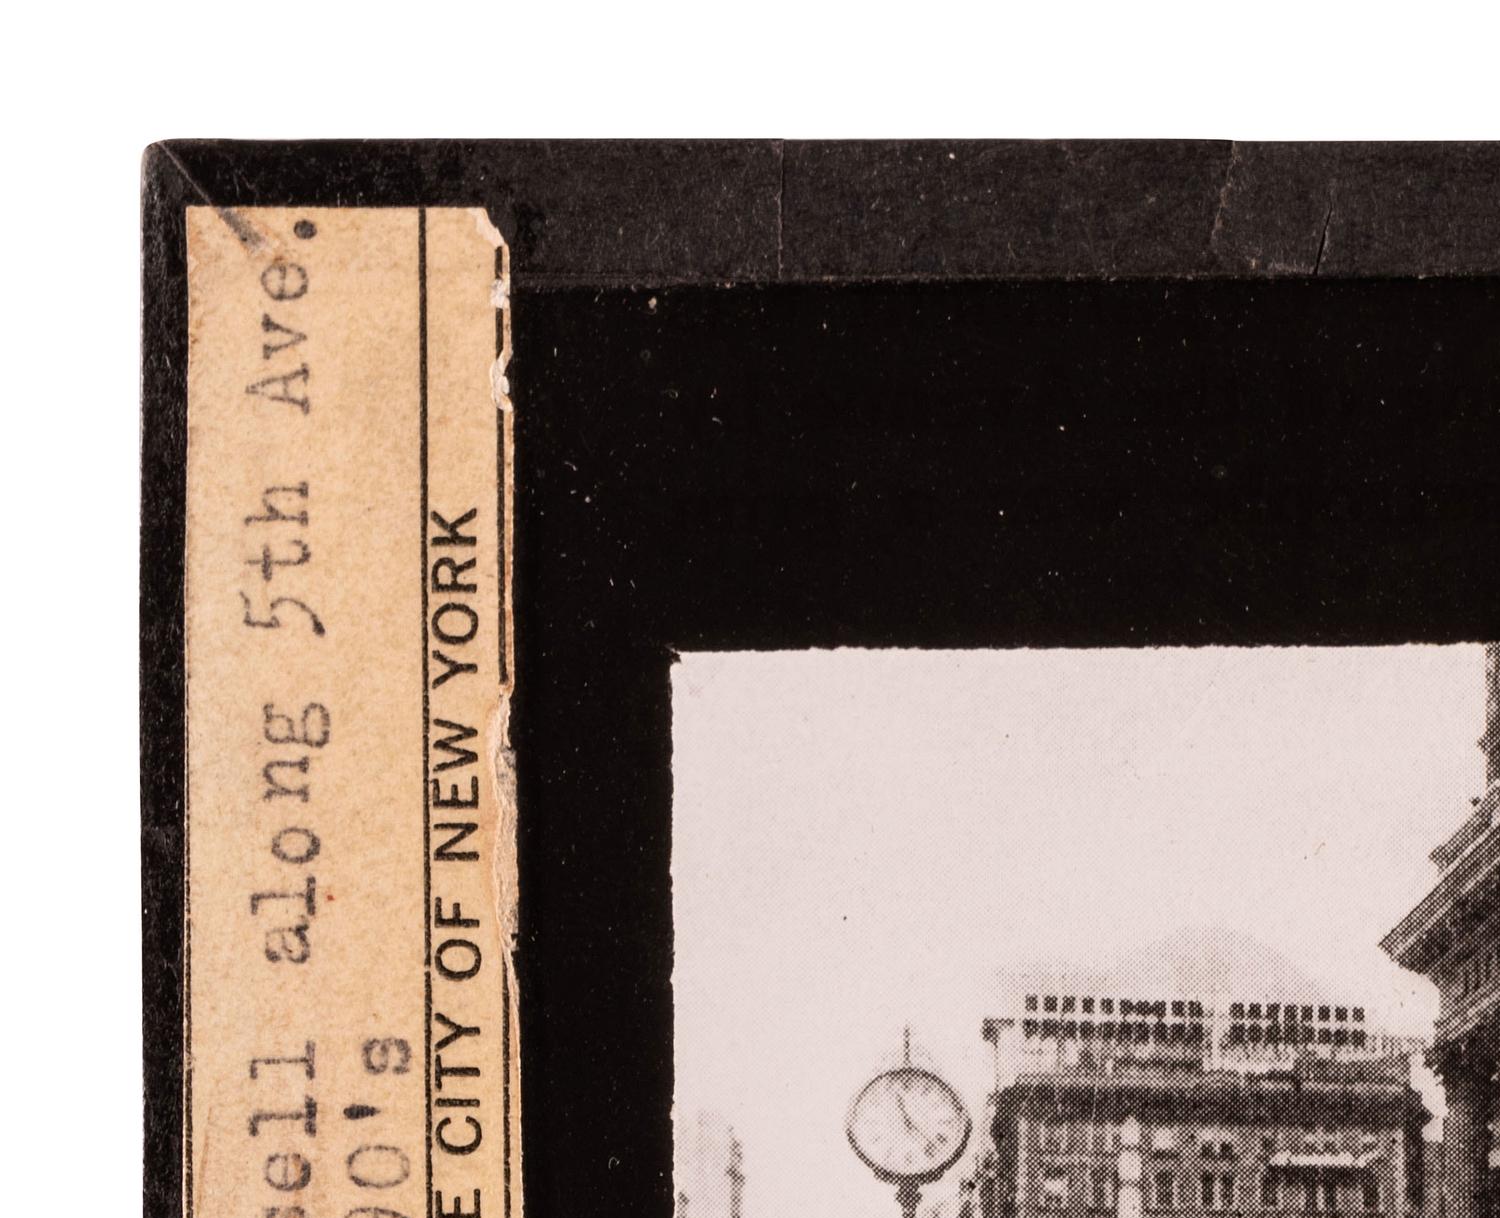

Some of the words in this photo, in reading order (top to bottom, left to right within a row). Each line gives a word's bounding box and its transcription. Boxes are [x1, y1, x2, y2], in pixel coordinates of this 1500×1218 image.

[243, 218, 318, 415] Ave.
[240, 480, 326, 638] 5th
[430, 507, 479, 689] YORK
[249, 702, 331, 965] along
[431, 718, 480, 862] NEW
[433, 896, 483, 983] OF
[433, 1011, 483, 1156] CITY
